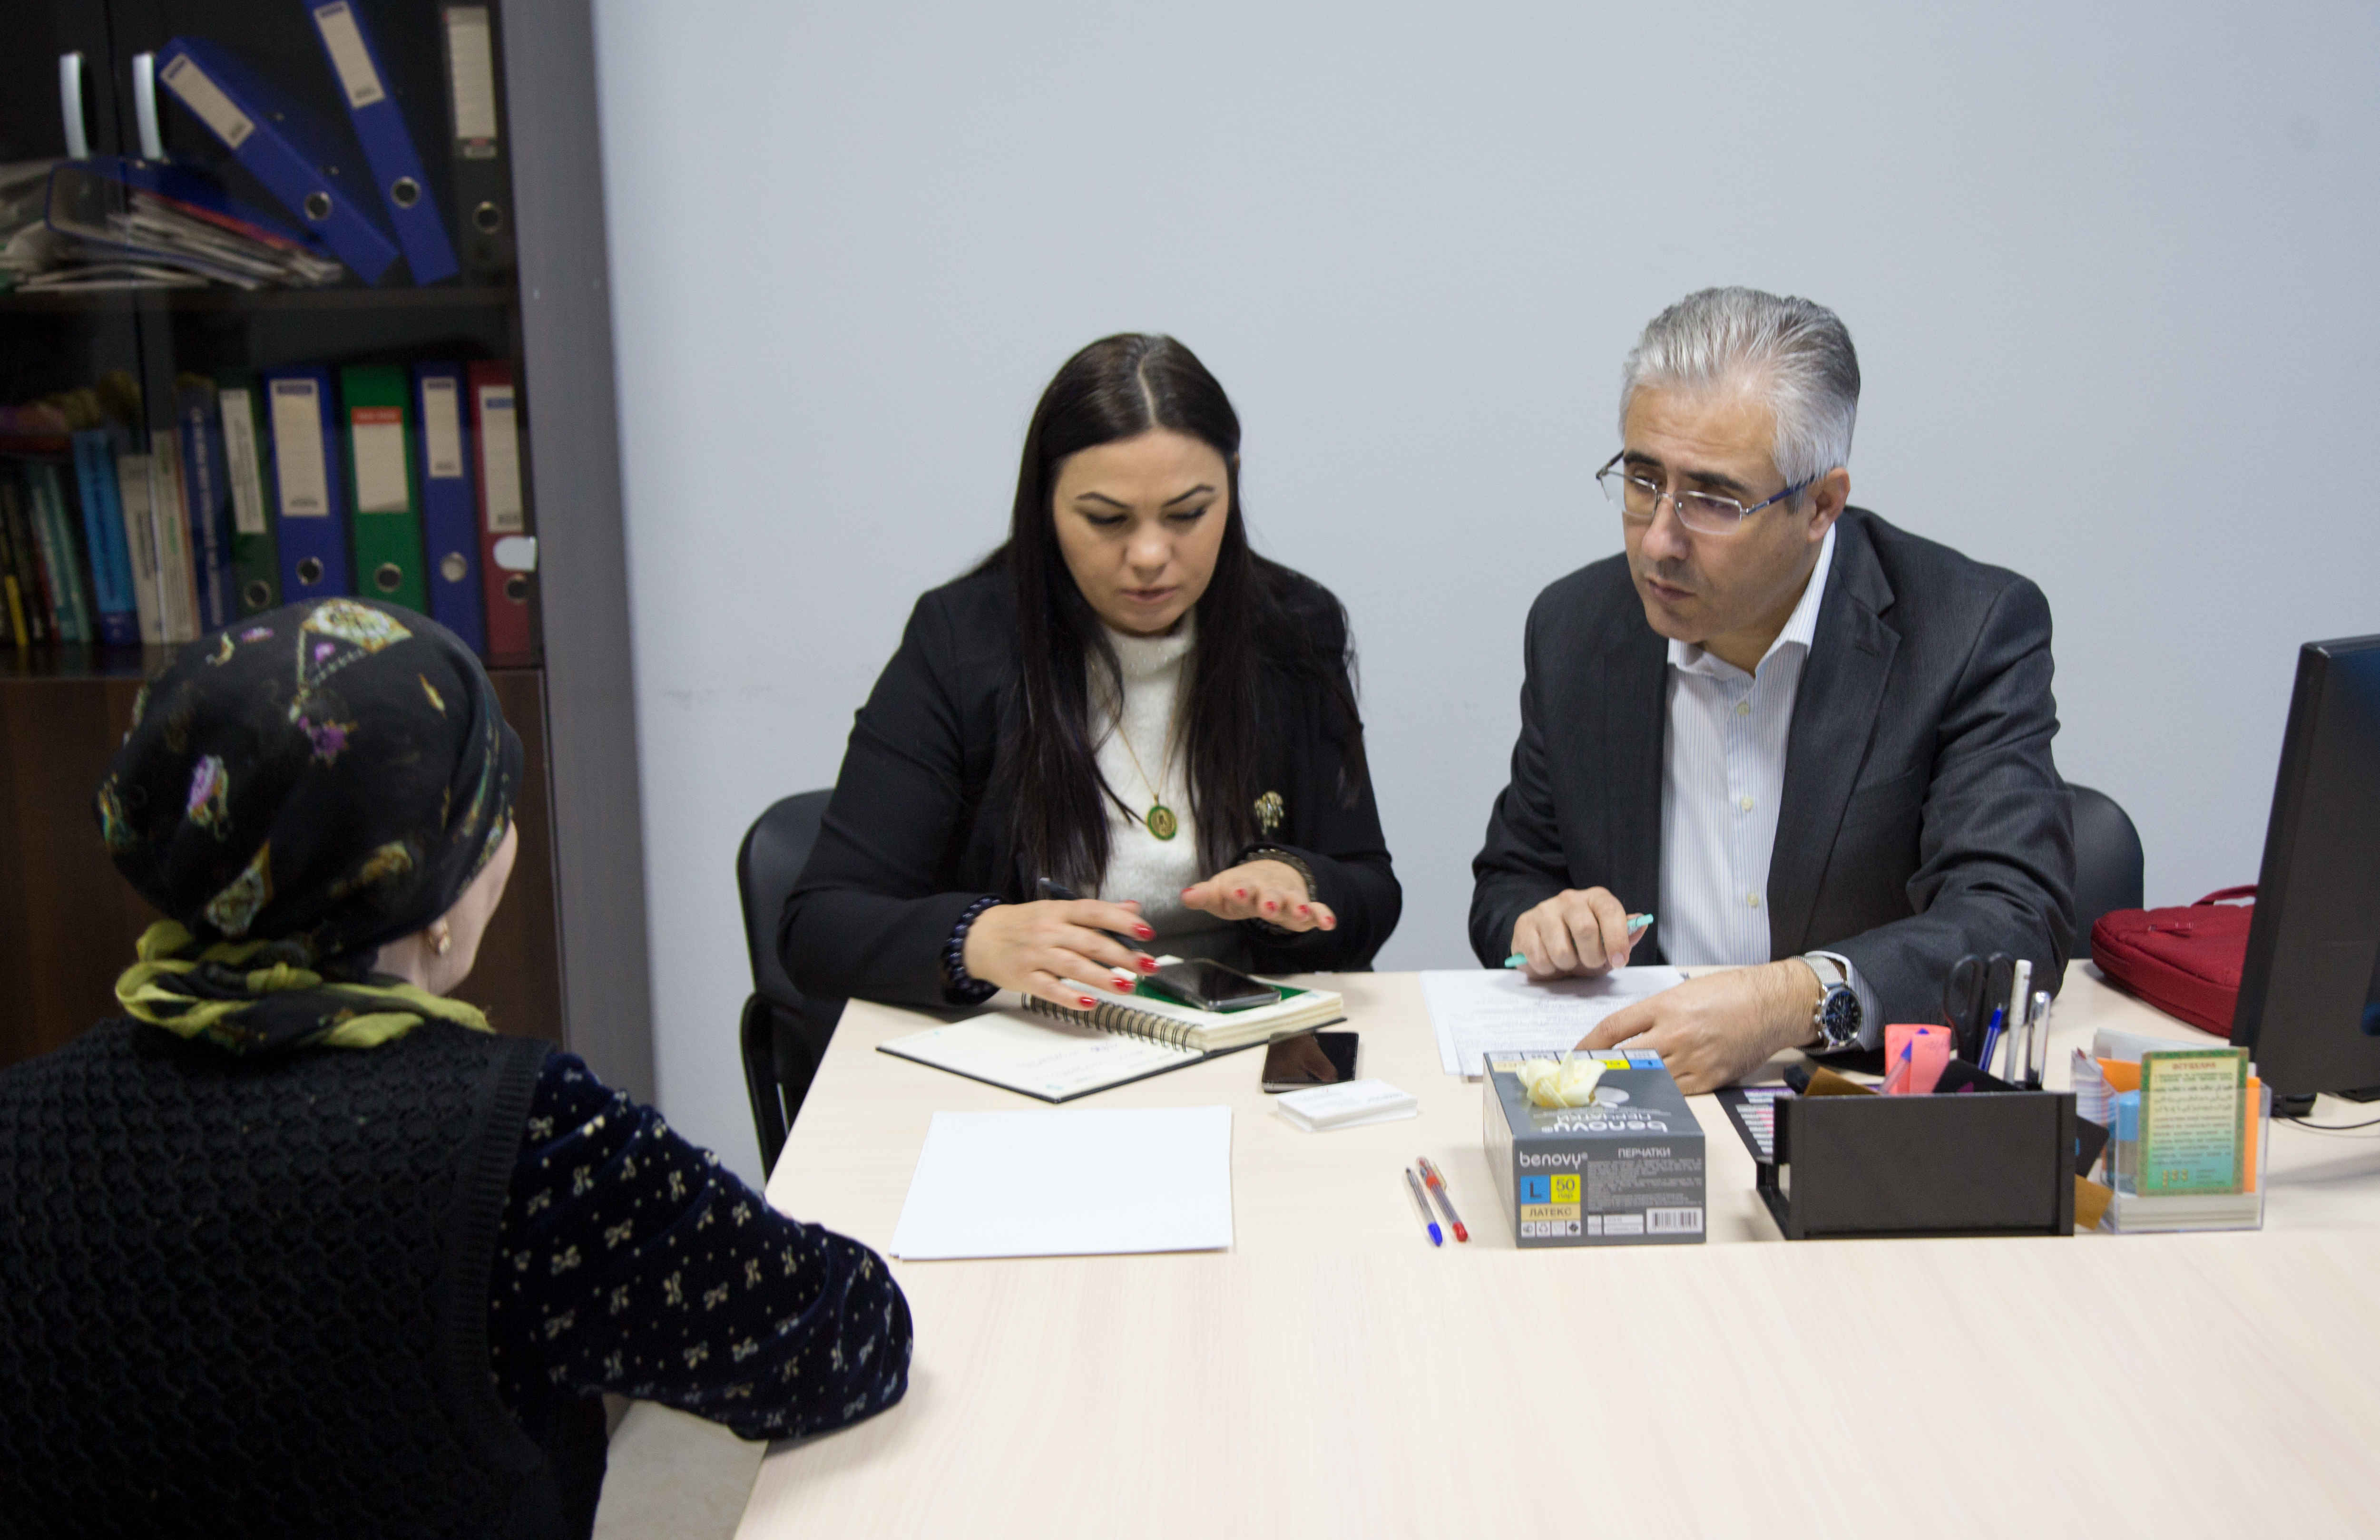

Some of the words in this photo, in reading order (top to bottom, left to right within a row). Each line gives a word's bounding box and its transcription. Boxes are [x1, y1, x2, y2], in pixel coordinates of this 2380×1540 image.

[1556, 1116, 1668, 1133] benovy
[1618, 1147, 1671, 1158] ПЕРЧАТКИ
[1520, 1150, 1581, 1170] benovy
[1529, 1180, 1542, 1198] L
[1556, 1179, 1575, 1191] 50
[1529, 1207, 1572, 1217] ЛАТЕКС
